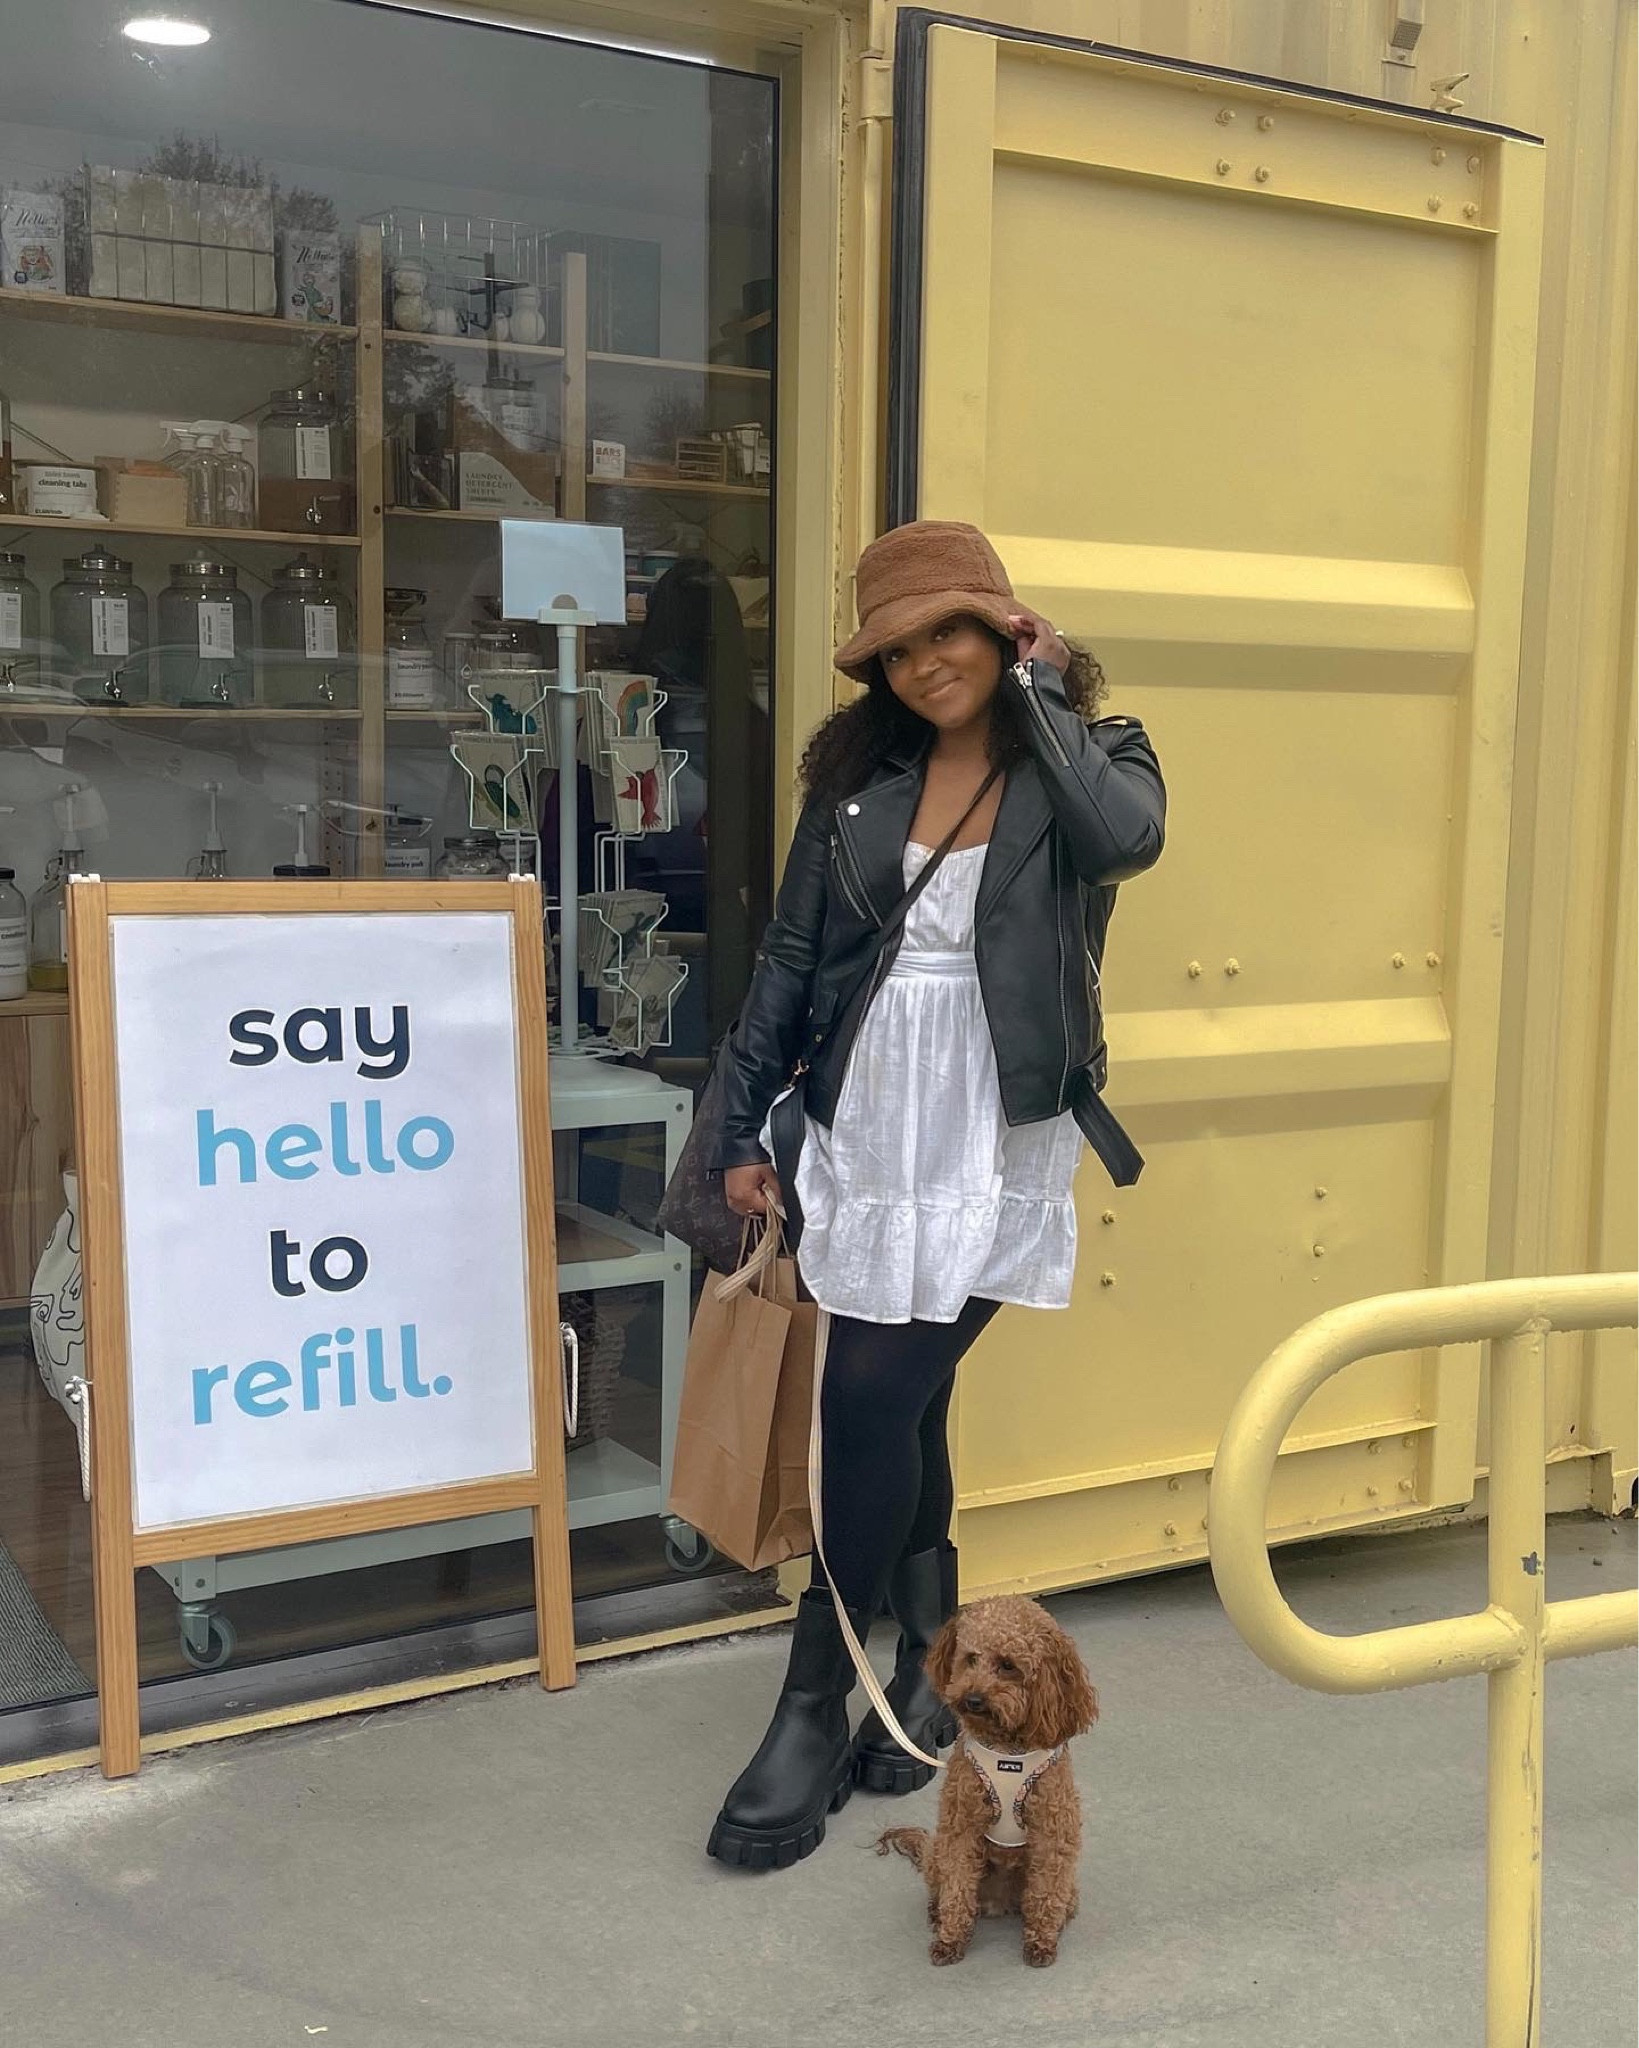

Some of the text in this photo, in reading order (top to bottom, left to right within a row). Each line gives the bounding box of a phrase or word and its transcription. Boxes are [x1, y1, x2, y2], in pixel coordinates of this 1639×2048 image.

[38, 479, 88, 488] cleaning tabs
[229, 1006, 411, 1080] say
[197, 1100, 455, 1186] hello
[270, 1230, 369, 1297] to
[193, 1325, 453, 1425] refill.
